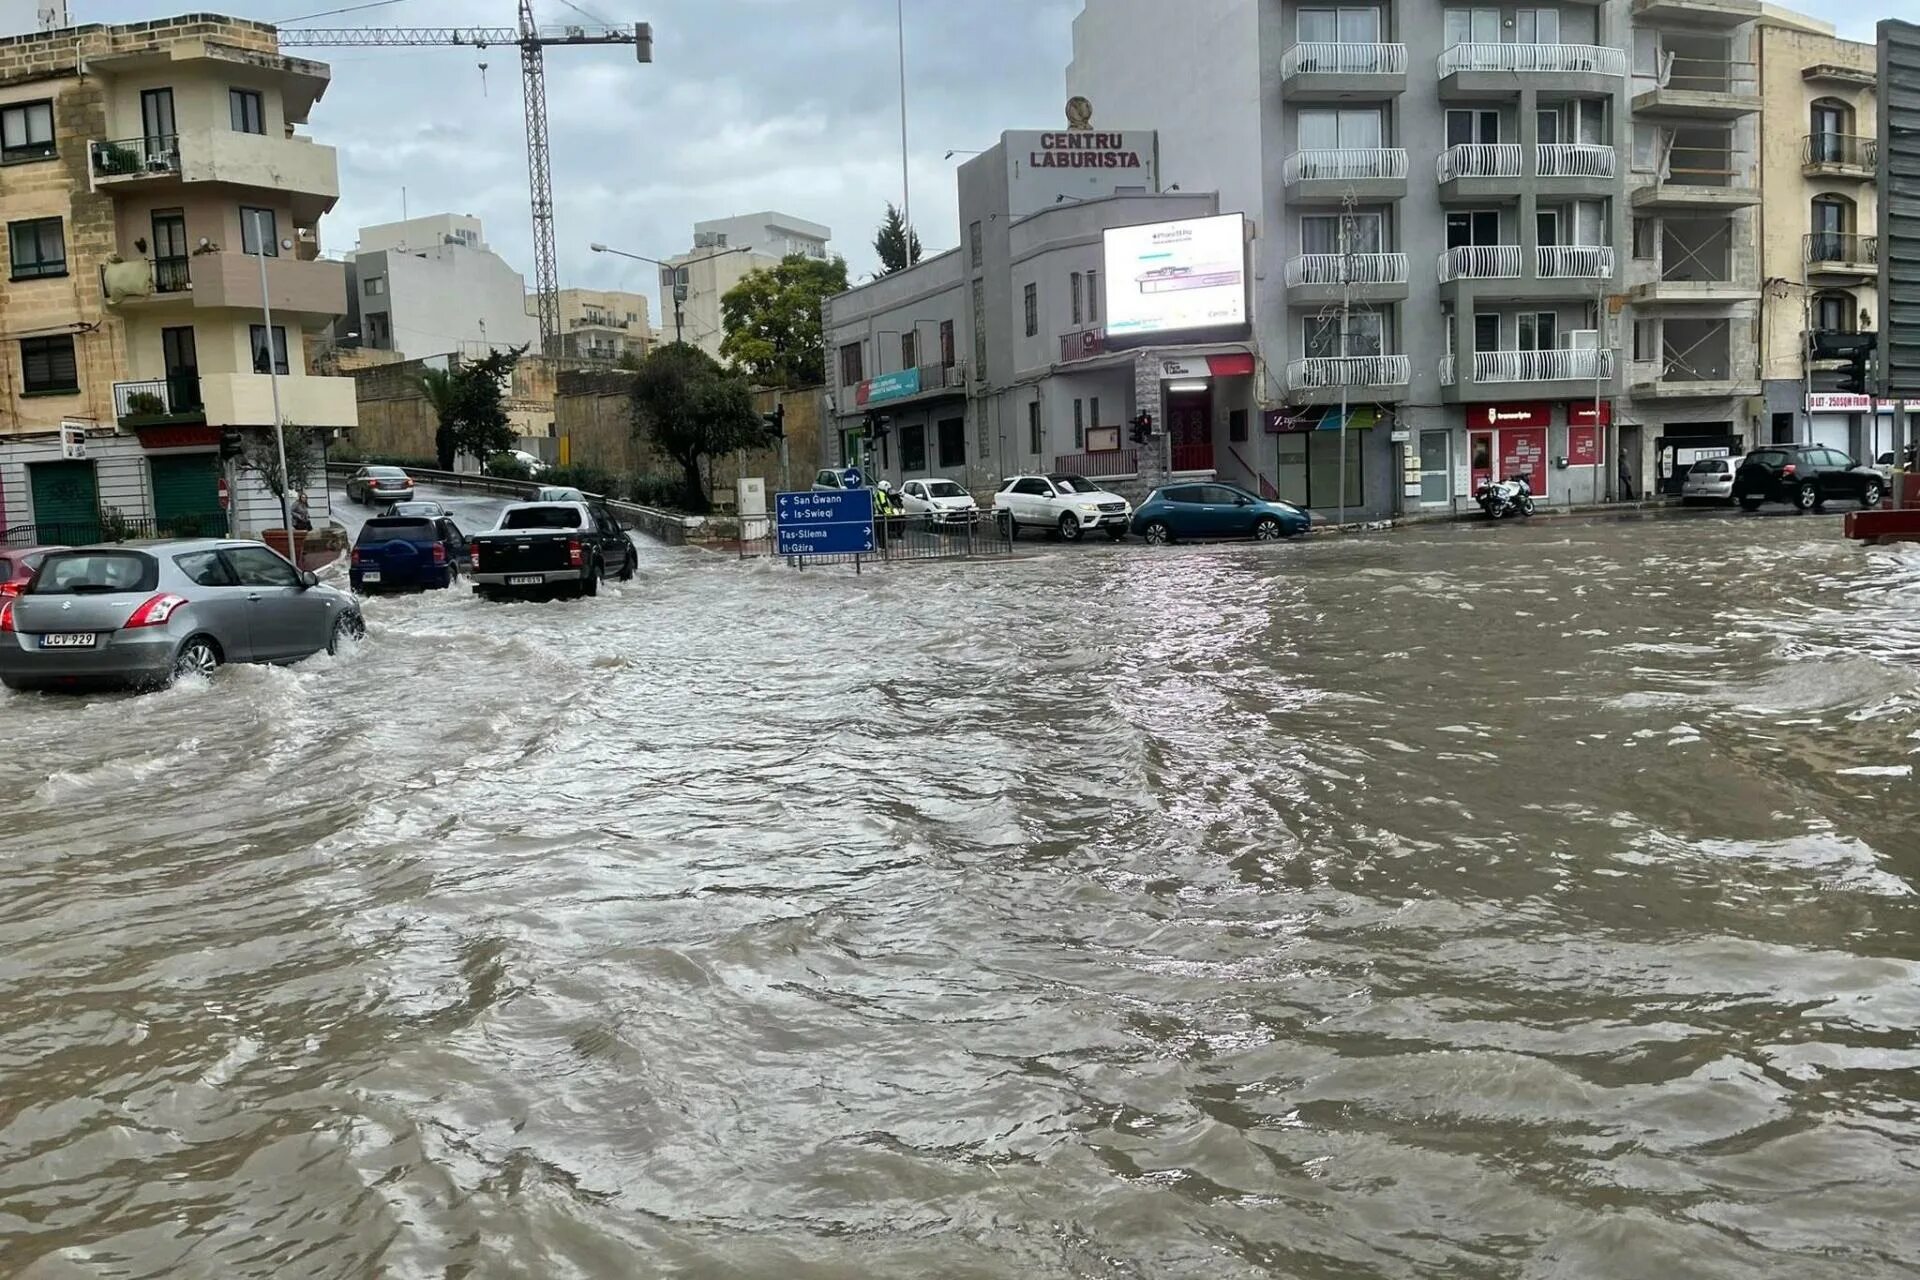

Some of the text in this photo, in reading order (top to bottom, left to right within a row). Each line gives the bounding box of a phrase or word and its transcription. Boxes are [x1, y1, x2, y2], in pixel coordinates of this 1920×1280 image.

[1040, 133, 1123, 149] CENTRU
[1030, 152, 1141, 168] LABURISTA
[793, 496, 810, 505] San
[794, 508, 833, 518] Is-Swieqi
[781, 529, 827, 539] Tas-Sliema
[72, 634, 92, 644] 929
